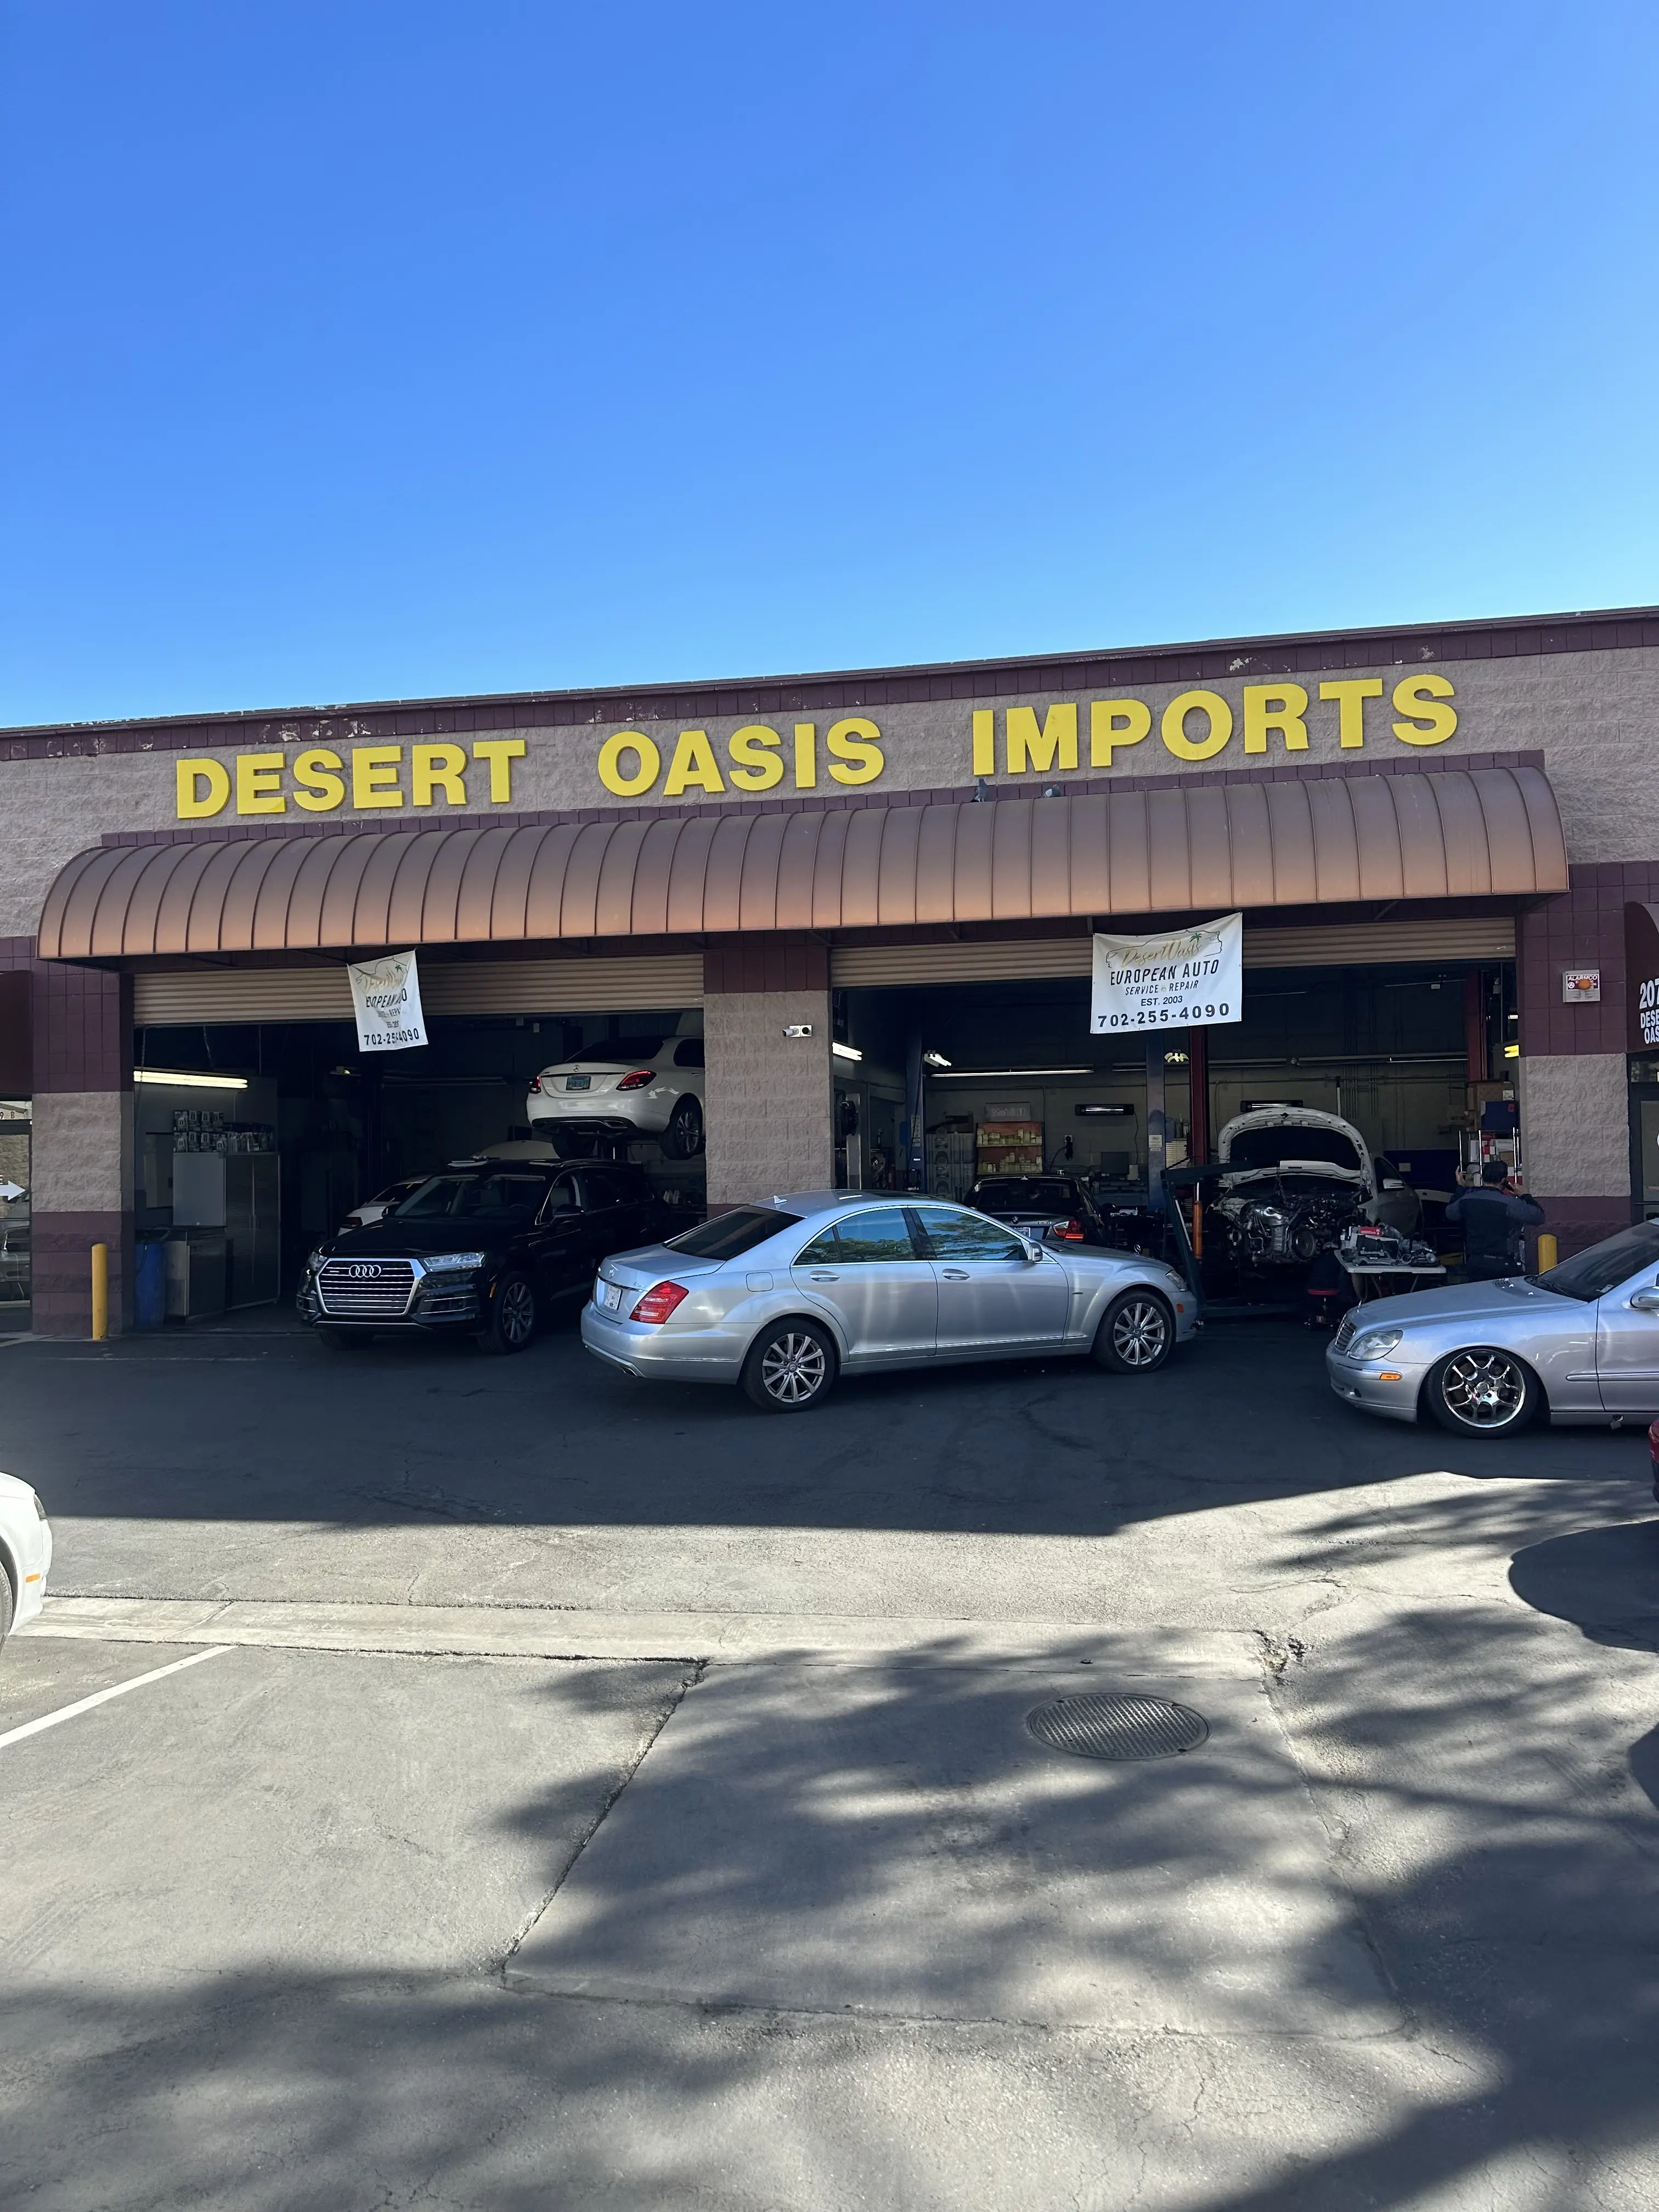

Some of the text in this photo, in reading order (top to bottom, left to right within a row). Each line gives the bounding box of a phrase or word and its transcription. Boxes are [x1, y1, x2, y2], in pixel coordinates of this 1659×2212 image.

[177, 674, 1458, 819] DESERT OASIS IMPORTS
[1110, 960, 1219, 985] EUROPEAN AUTO
[1125, 985, 1159, 996] SERVICE
[1169, 980, 1199, 991] REPAIR
[1141, 996, 1183, 1006] EST. 2003
[1098, 1003, 1229, 1028] 702-255-4090
[10, 1111, 15, 1119] B
